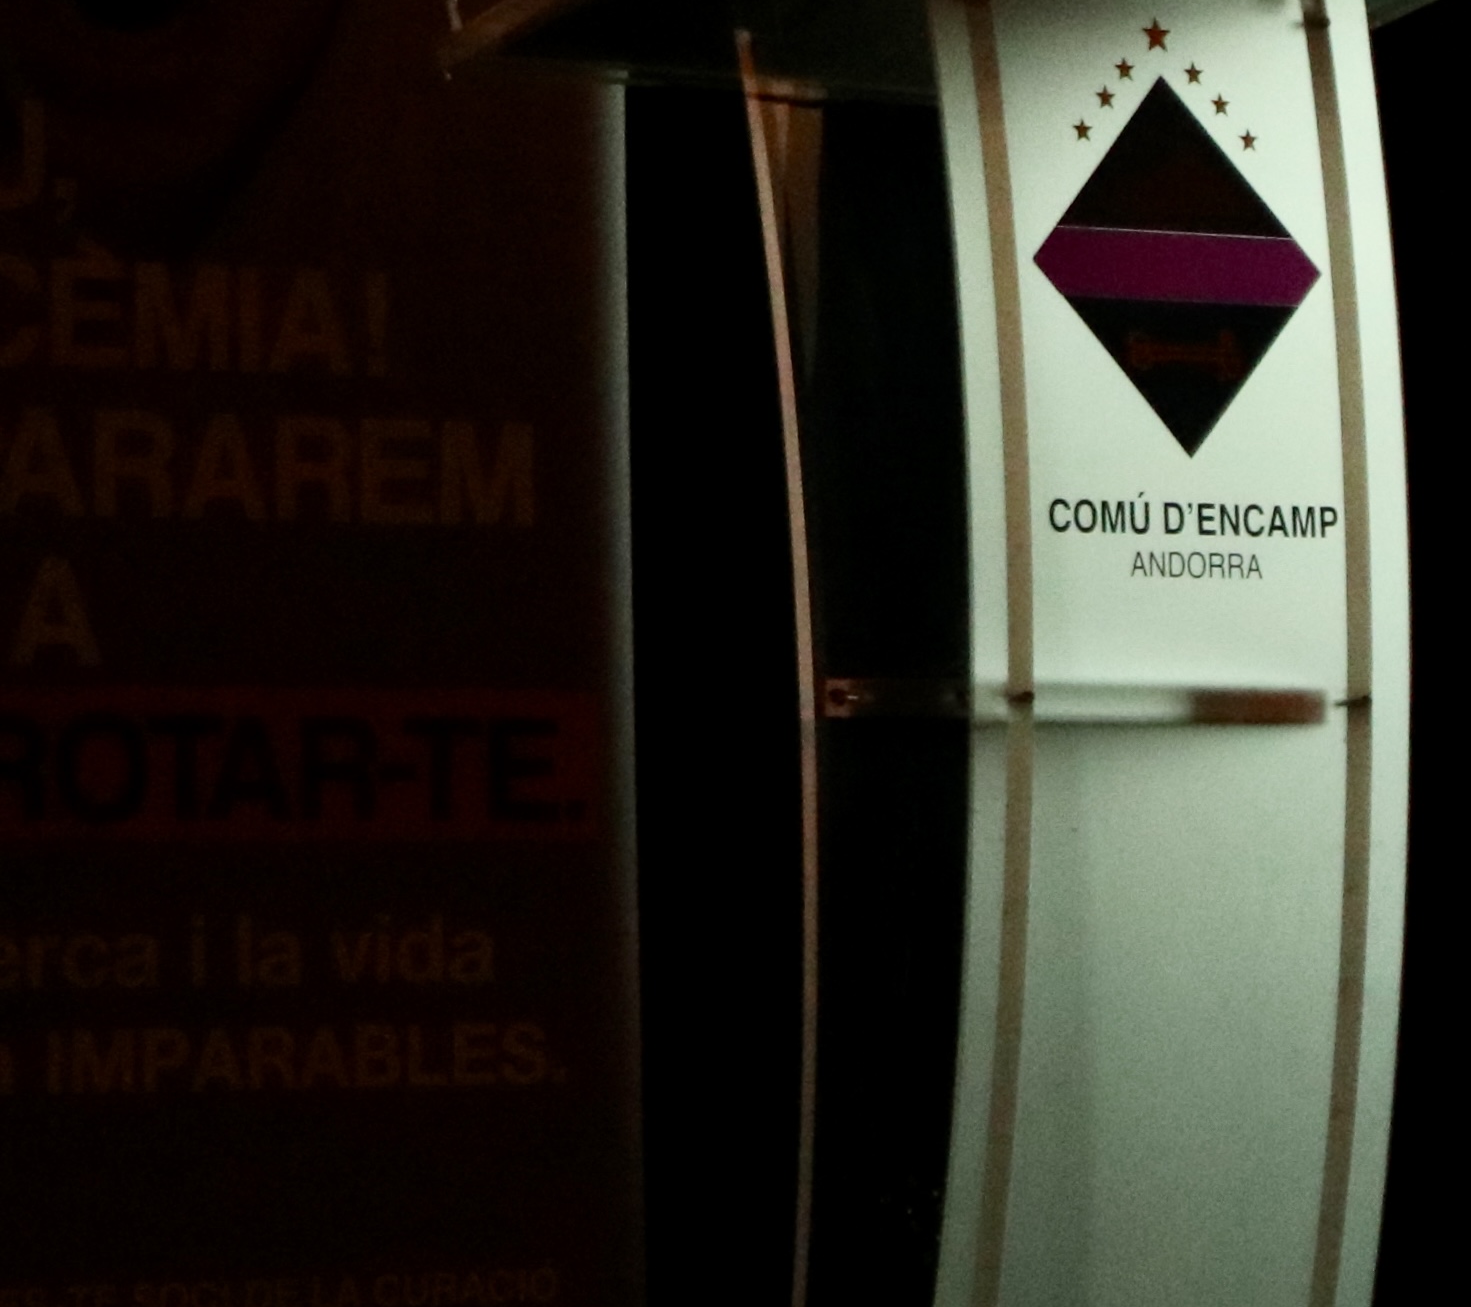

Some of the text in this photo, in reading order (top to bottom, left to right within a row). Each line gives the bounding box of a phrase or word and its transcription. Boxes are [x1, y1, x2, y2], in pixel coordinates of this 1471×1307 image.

[1049, 491, 1150, 535] COMÚ
[1130, 550, 1263, 581] ANDORRA
[190, 913, 207, 986] i
[236, 913, 301, 986] la
[330, 913, 496, 986] vida
[46, 1022, 568, 1094] IMPARABLES.
